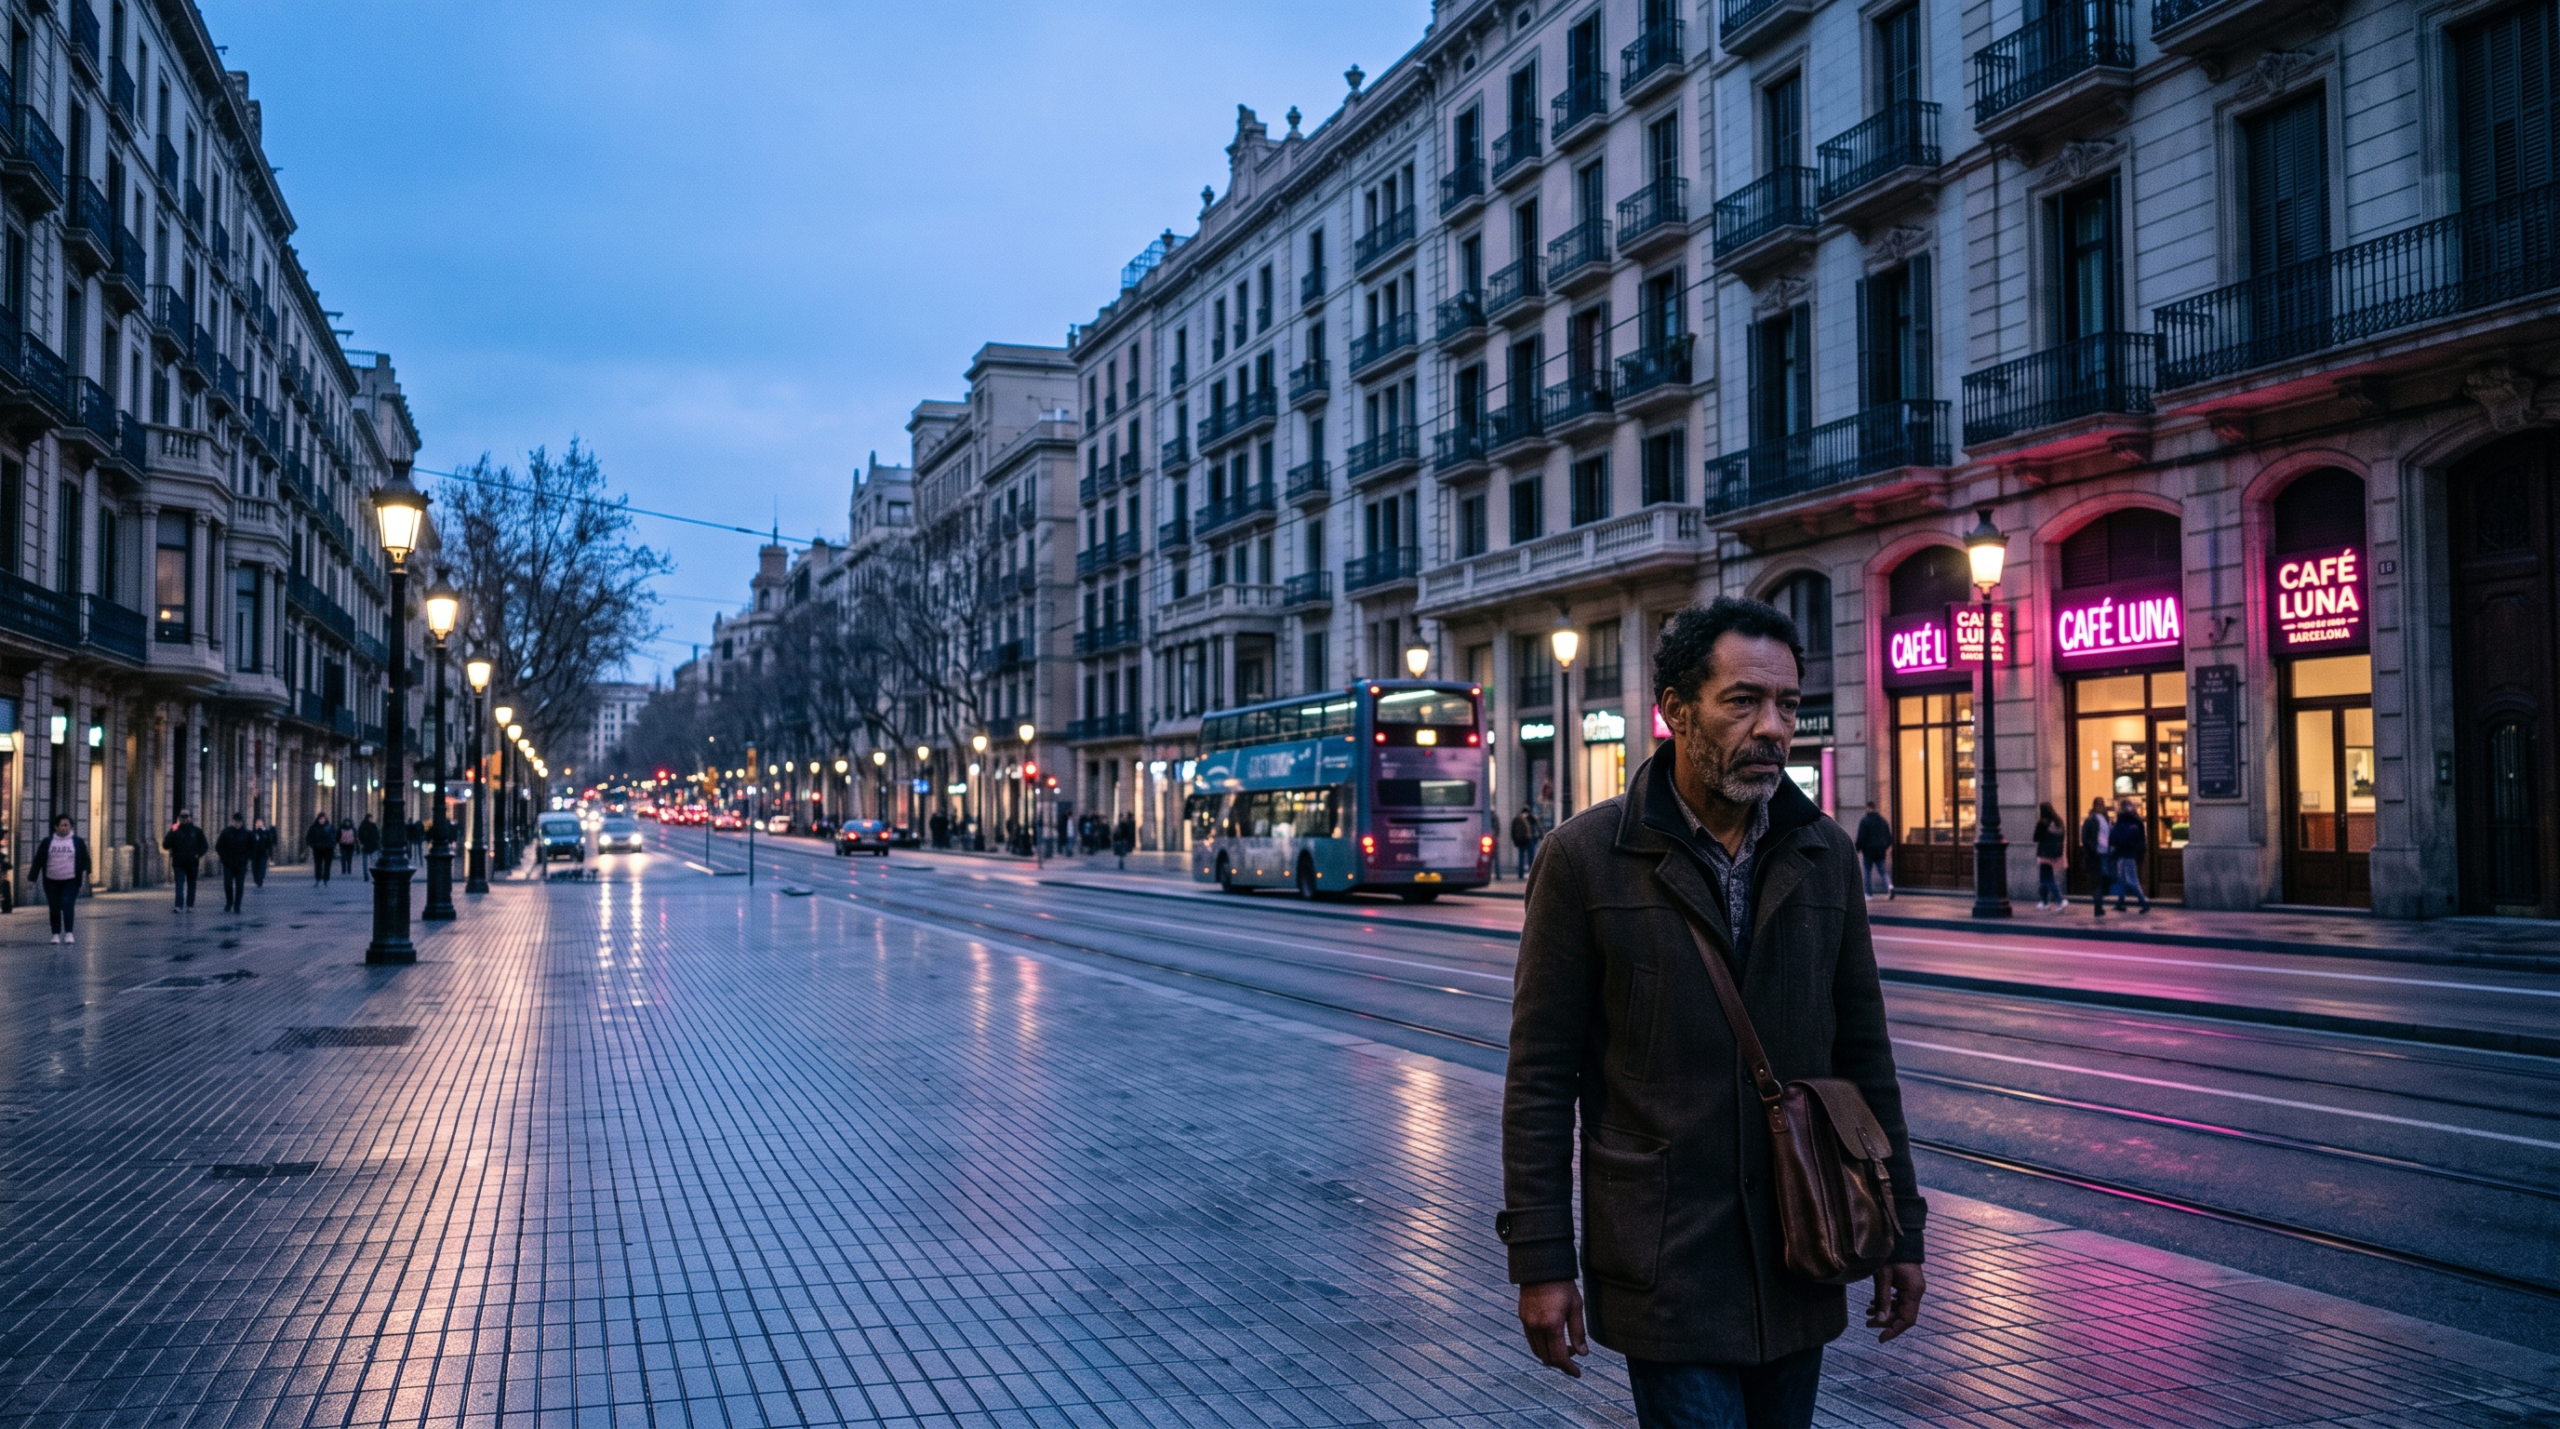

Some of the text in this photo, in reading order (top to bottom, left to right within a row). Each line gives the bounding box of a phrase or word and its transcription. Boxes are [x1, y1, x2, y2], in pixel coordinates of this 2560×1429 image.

[2279, 548, 2357, 589] CAFÉ
[2058, 596, 2180, 651] CAFÉ LUNA
[2279, 585, 2360, 620] LUNA
[1891, 622, 1932, 669] CAFÉ
